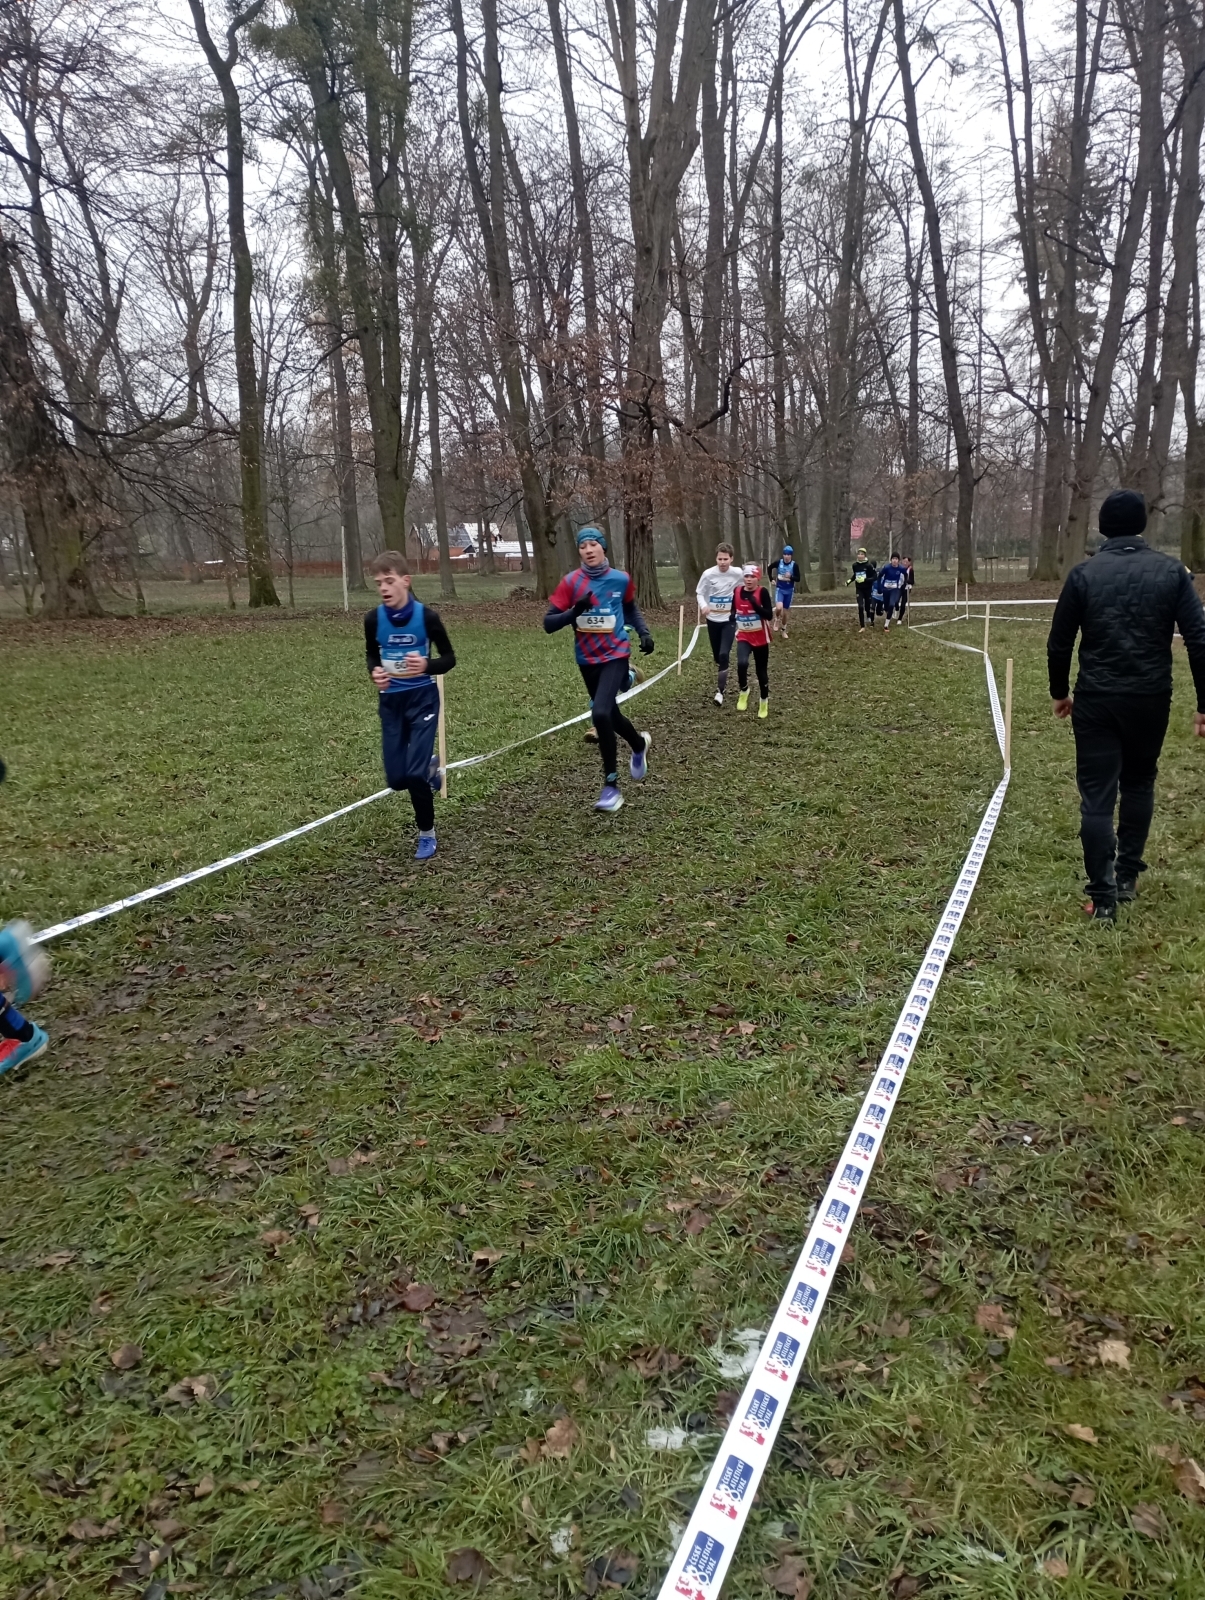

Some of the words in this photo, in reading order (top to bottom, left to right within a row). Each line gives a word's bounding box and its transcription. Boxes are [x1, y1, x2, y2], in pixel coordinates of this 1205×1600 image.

[586, 616, 605, 625] 634
[722, 1466, 733, 1486] ČESKÝ
[730, 1459, 745, 1490] ATLETICKÝ
[736, 1477, 747, 1494] SVAZ
[689, 1545, 702, 1566] ČESKÝ
[698, 1536, 715, 1572] ATLETICKÝ
[706, 1557, 717, 1576] SVAZ
